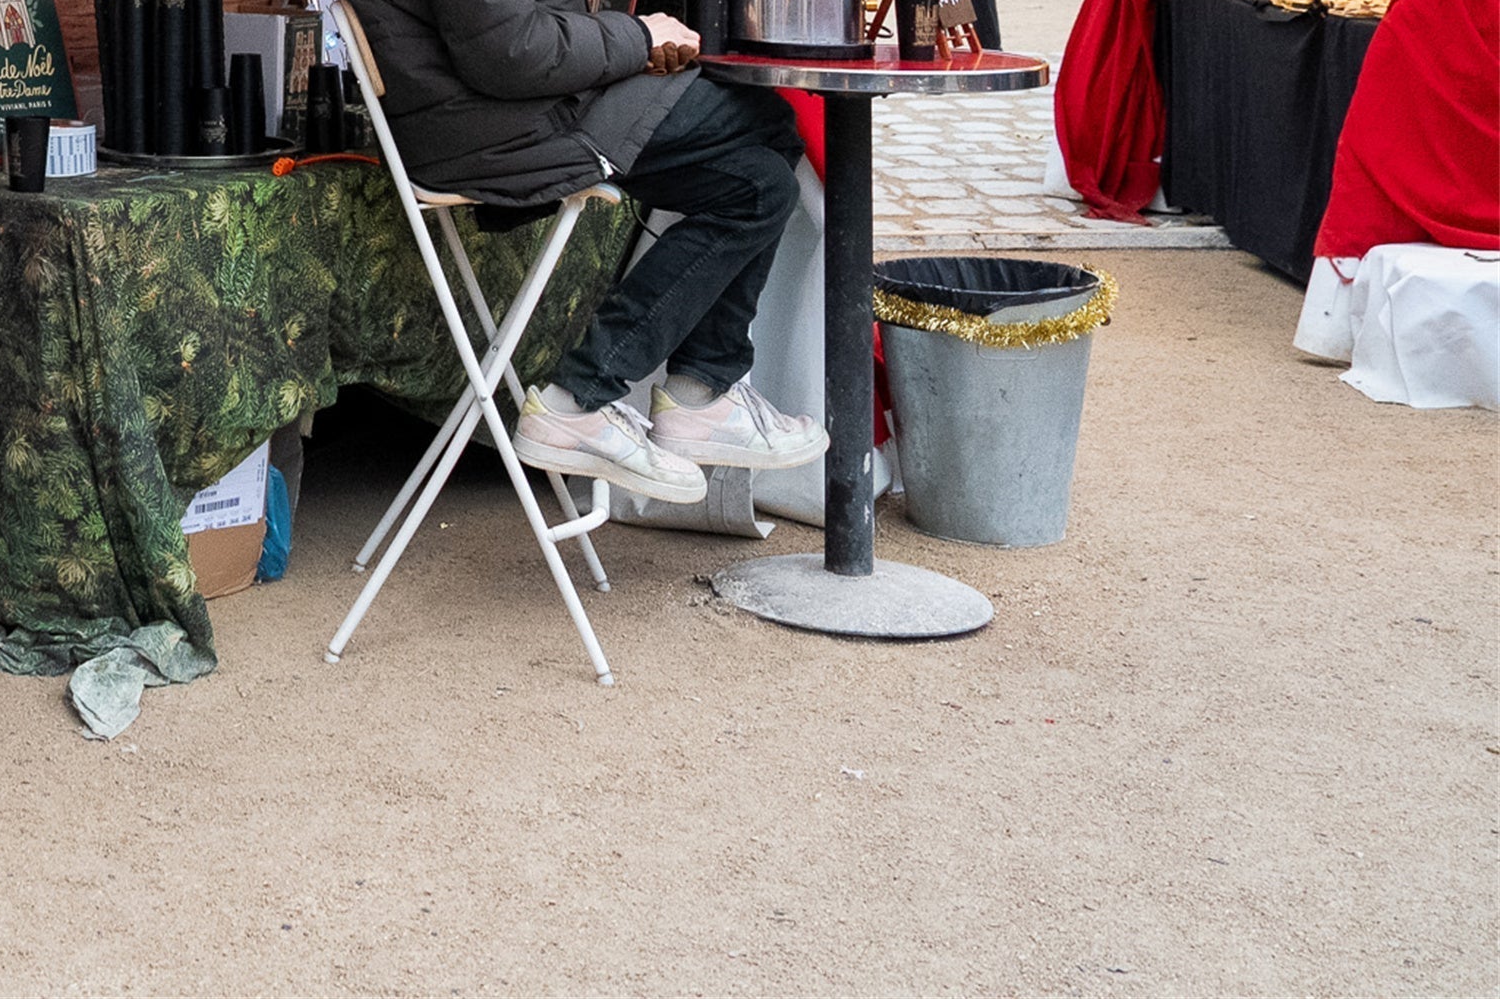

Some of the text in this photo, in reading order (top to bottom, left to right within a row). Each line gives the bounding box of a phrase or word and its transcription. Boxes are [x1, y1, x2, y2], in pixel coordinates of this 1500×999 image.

[0, 57, 22, 79] de
[21, 44, 55, 79] Noël
[28, 101, 46, 109] PARIS
